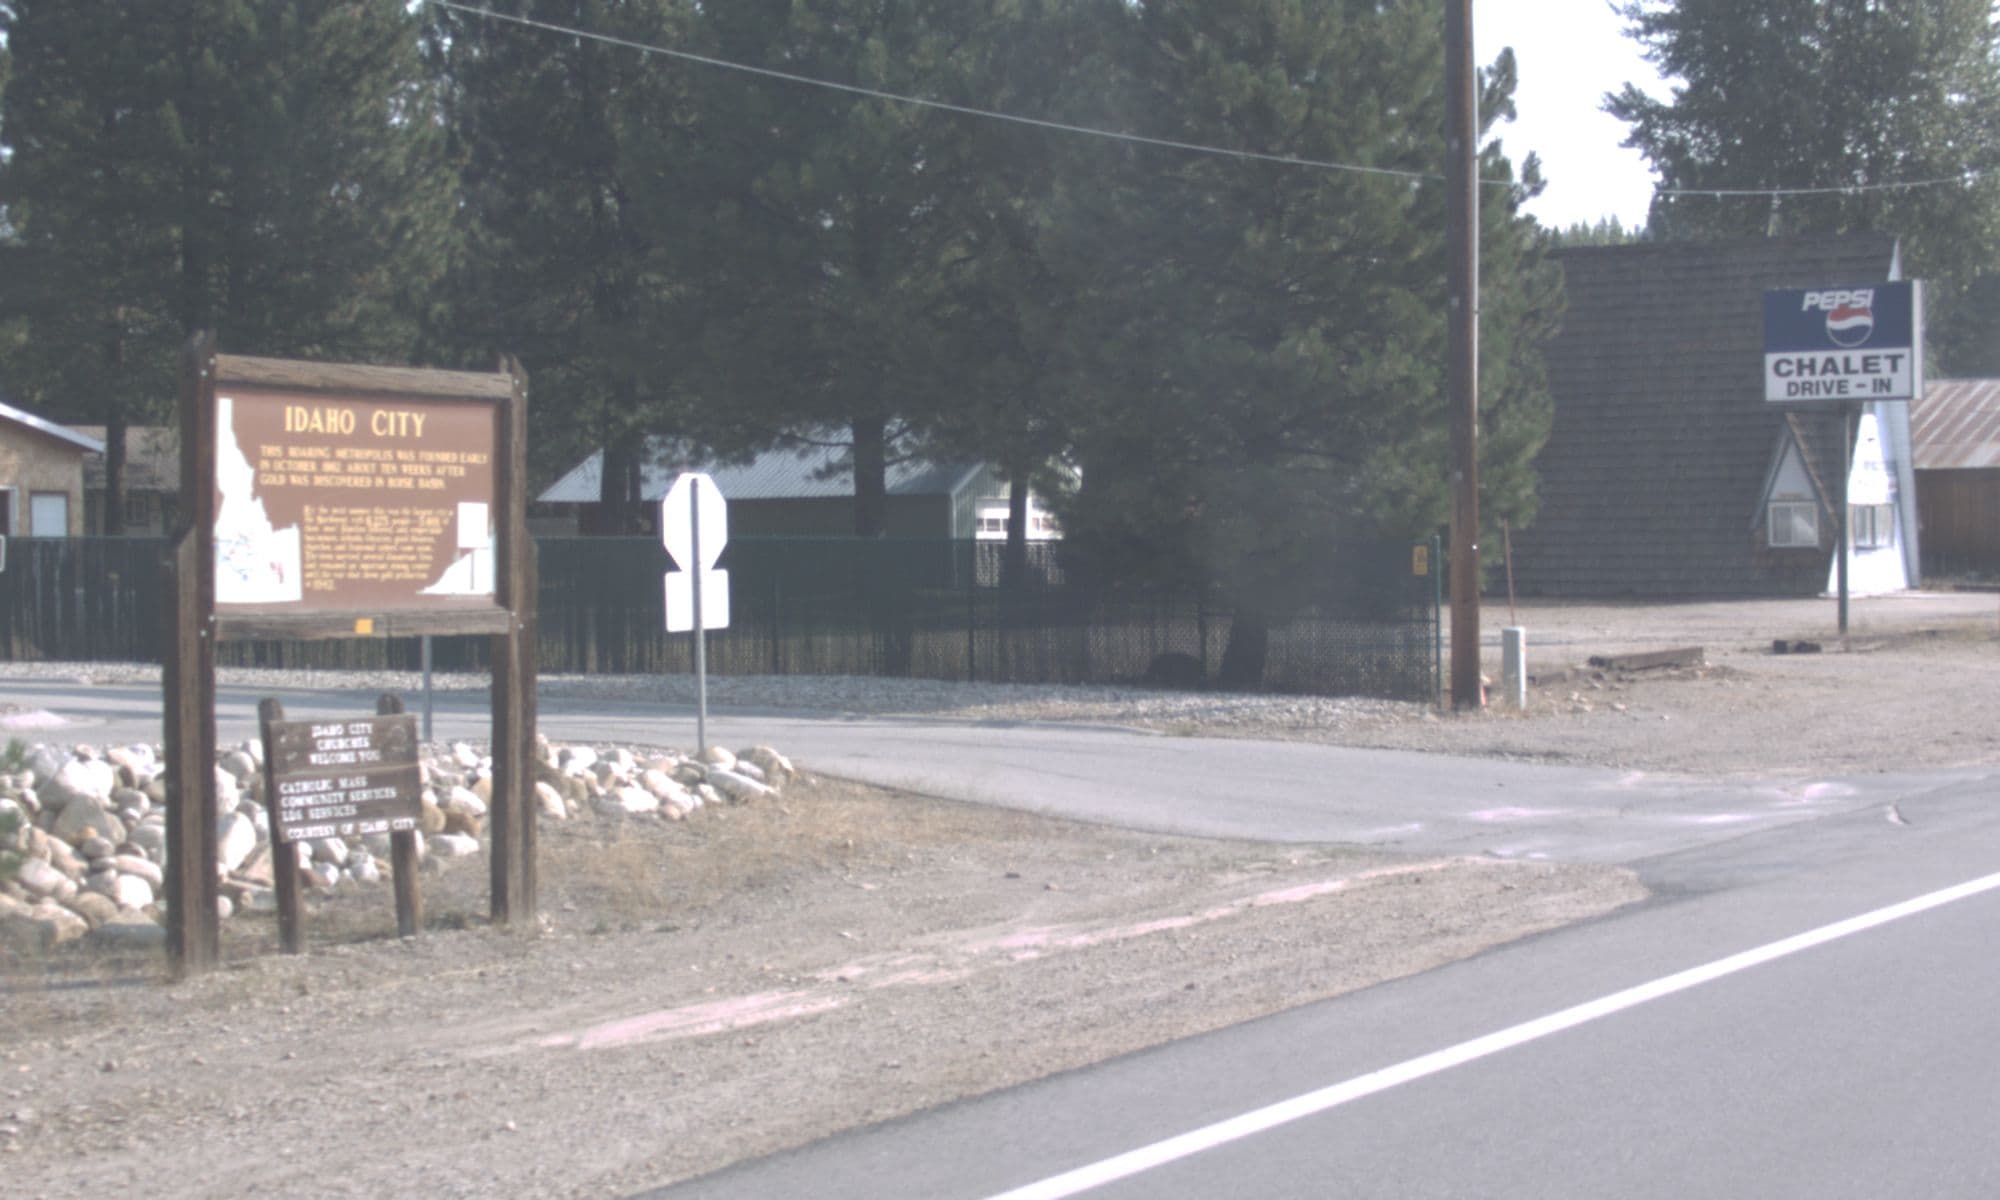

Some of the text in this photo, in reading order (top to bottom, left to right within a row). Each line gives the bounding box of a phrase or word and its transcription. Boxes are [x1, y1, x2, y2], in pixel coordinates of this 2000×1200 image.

[1801, 288, 1875, 311] PEPSI
[1773, 354, 1905, 378] CHALET
[285, 406, 426, 437] IDAHO CITY
[259, 473, 286, 486] GOLD
[311, 723, 373, 738] IDAHO CITY
[316, 737, 370, 750] CHURCHES
[309, 752, 356, 765] WELCOME
[279, 776, 368, 794] CATHOLIC MASS
[281, 787, 397, 808] COMMUNITY SERVICES
[308, 805, 358, 819] SERVICES
[287, 817, 416, 840] COURTESY OF IDAHO CITY
